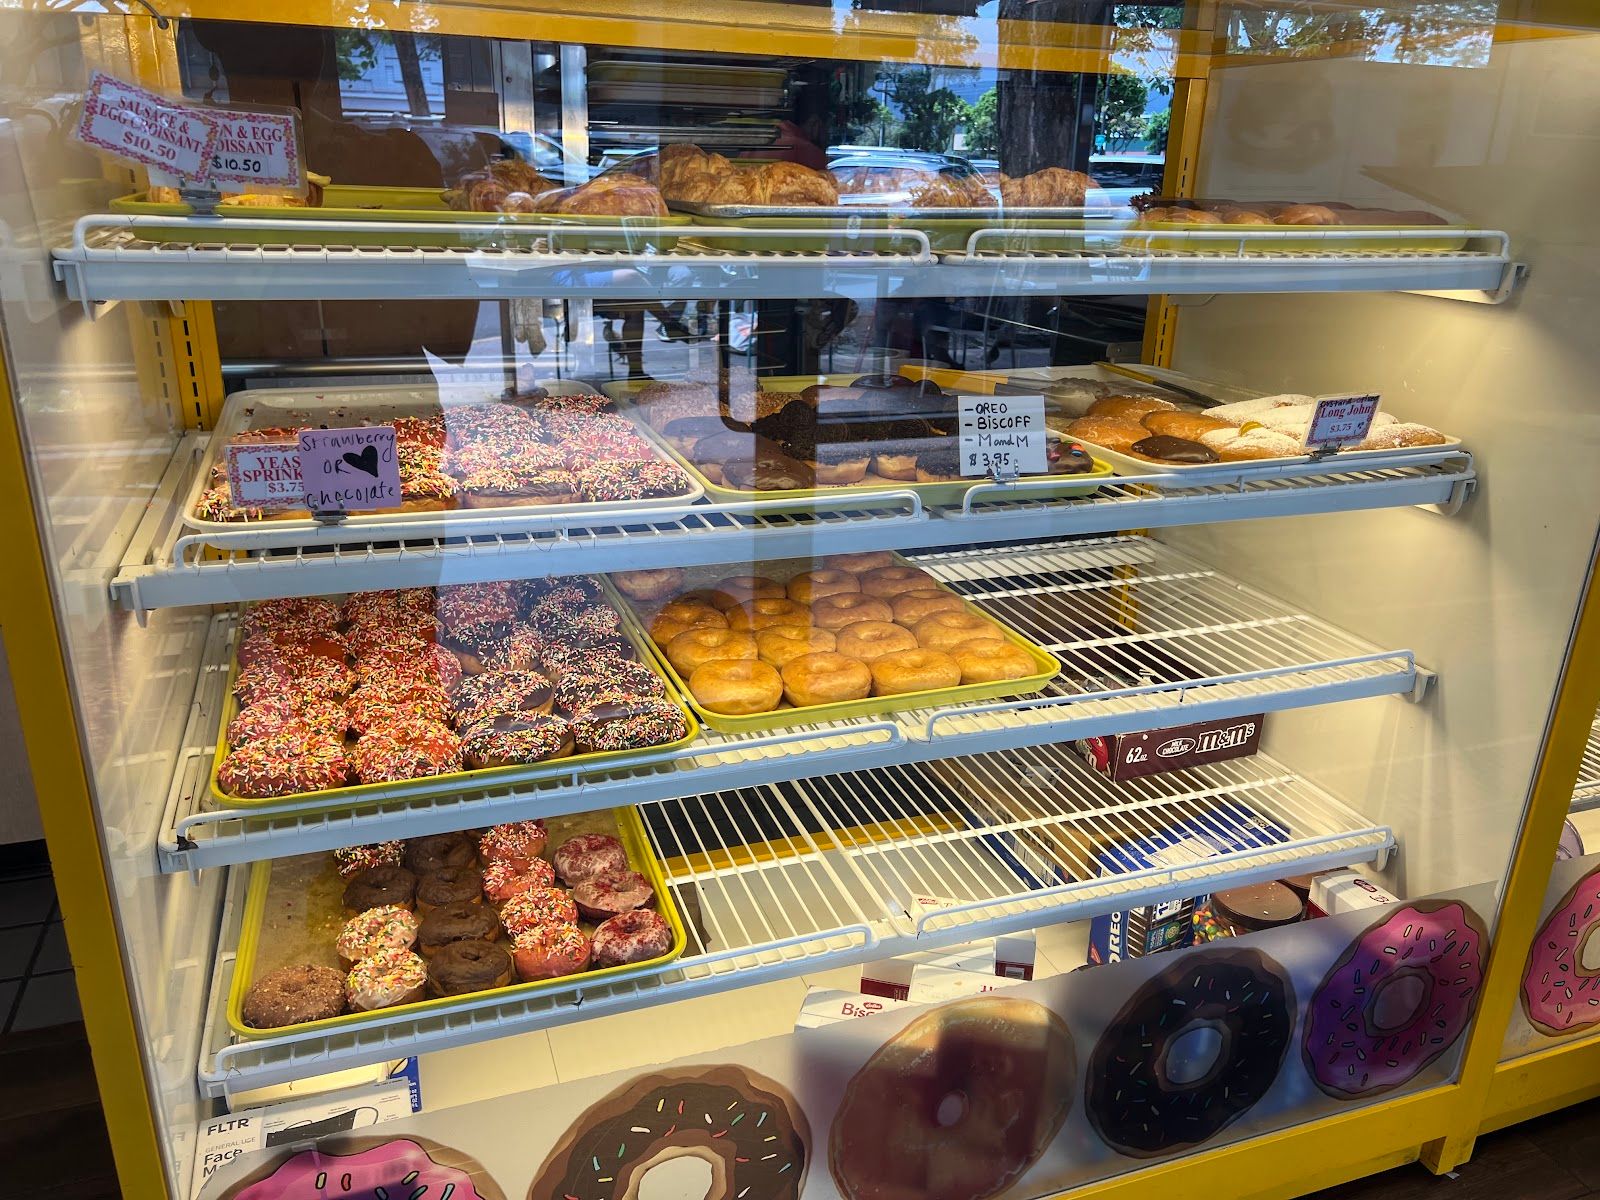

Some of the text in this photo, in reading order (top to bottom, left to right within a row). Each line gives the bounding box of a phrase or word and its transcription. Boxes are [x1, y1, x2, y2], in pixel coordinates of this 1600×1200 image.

[118, 96, 190, 134] SAUSAGE &
[100, 103, 127, 125] EGG
[131, 115, 202, 153] CROISSANT
[236, 125, 249, 139] &
[251, 126, 283, 142] EGG
[123, 131, 176, 161] $10.50
[216, 138, 275, 156] OISSANT
[212, 154, 261, 173] $10.50
[1321, 405, 1371, 419] Long John
[256, 457, 300, 470] YEAS
[324, 458, 351, 475] OR
[243, 468, 303, 483] SPRINK
[1125, 747, 1142, 764] 62
[1162, 744, 1190, 755] CHOCOLATE
[207, 1118, 250, 1136] FLTR
[205, 1141, 240, 1154] GENERAL
[204, 1148, 243, 1166] Face
